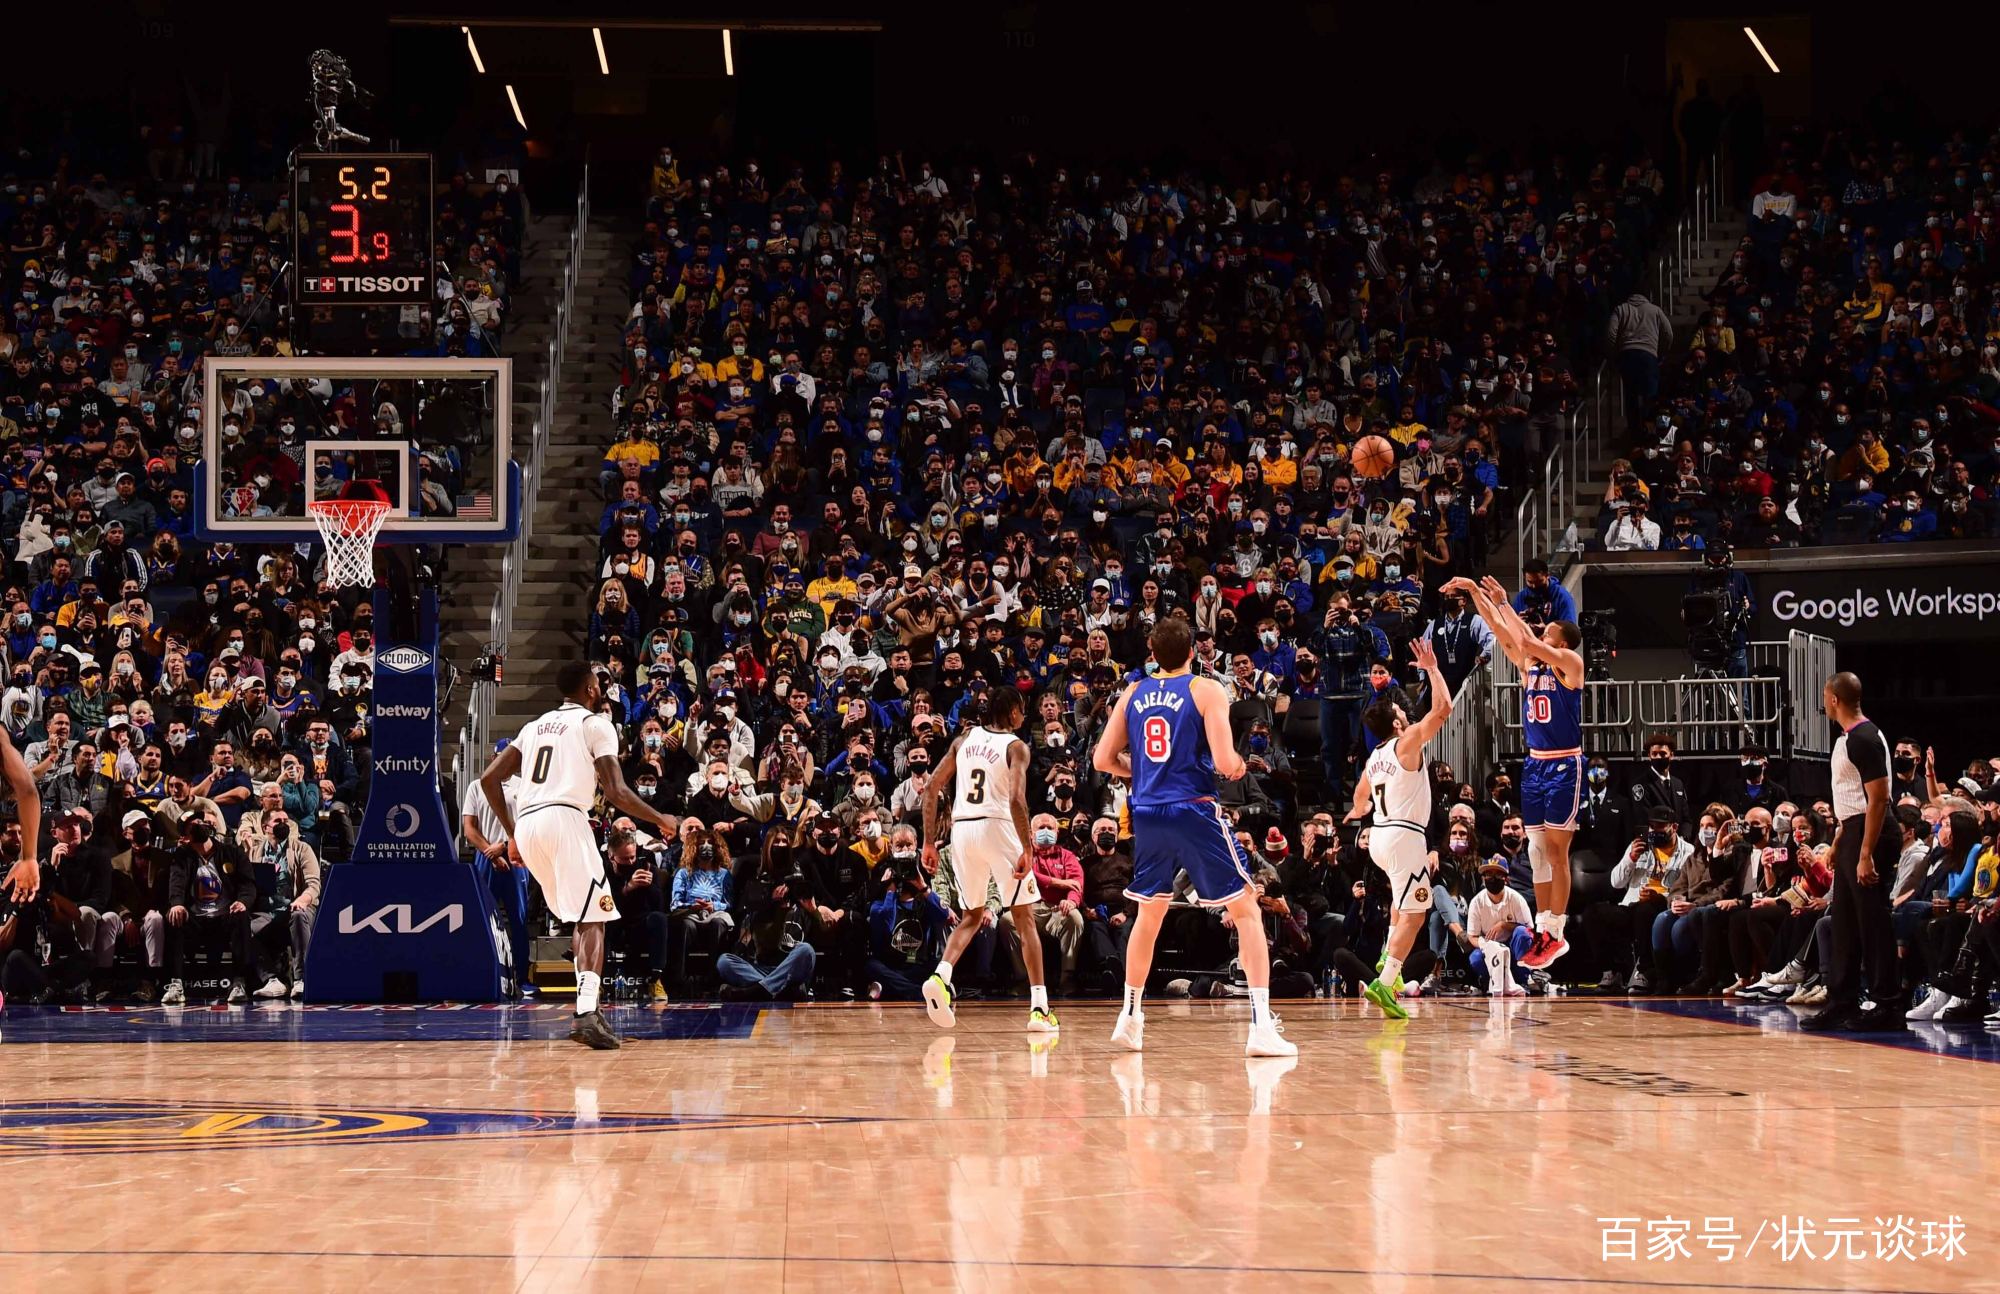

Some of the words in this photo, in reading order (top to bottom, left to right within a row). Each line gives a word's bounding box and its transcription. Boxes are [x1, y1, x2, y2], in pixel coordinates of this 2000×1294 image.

[338, 166, 391, 200] 5.2
[330, 204, 390, 263] 3.9
[337, 277, 425, 292] TISSOT
[1772, 588, 1880, 627] Google
[1886, 586, 2000, 621] Worksp
[384, 653, 425, 664] CLOROX
[376, 704, 432, 719] betway
[1133, 691, 1184, 714] BJELICA
[1527, 694, 1552, 724] 30
[537, 722, 569, 736] GREEN
[1144, 716, 1171, 763] 8
[375, 755, 431, 775] xfinity
[531, 745, 554, 784] 0
[965, 745, 1000, 764] HYLAND
[966, 768, 986, 805] 3
[1374, 783, 1388, 817] 7
[367, 843, 436, 851] GLOBALIZATION
[370, 851, 434, 859] PARTNERS
[338, 903, 464, 934] KIA
[184, 979, 219, 989] HASE
